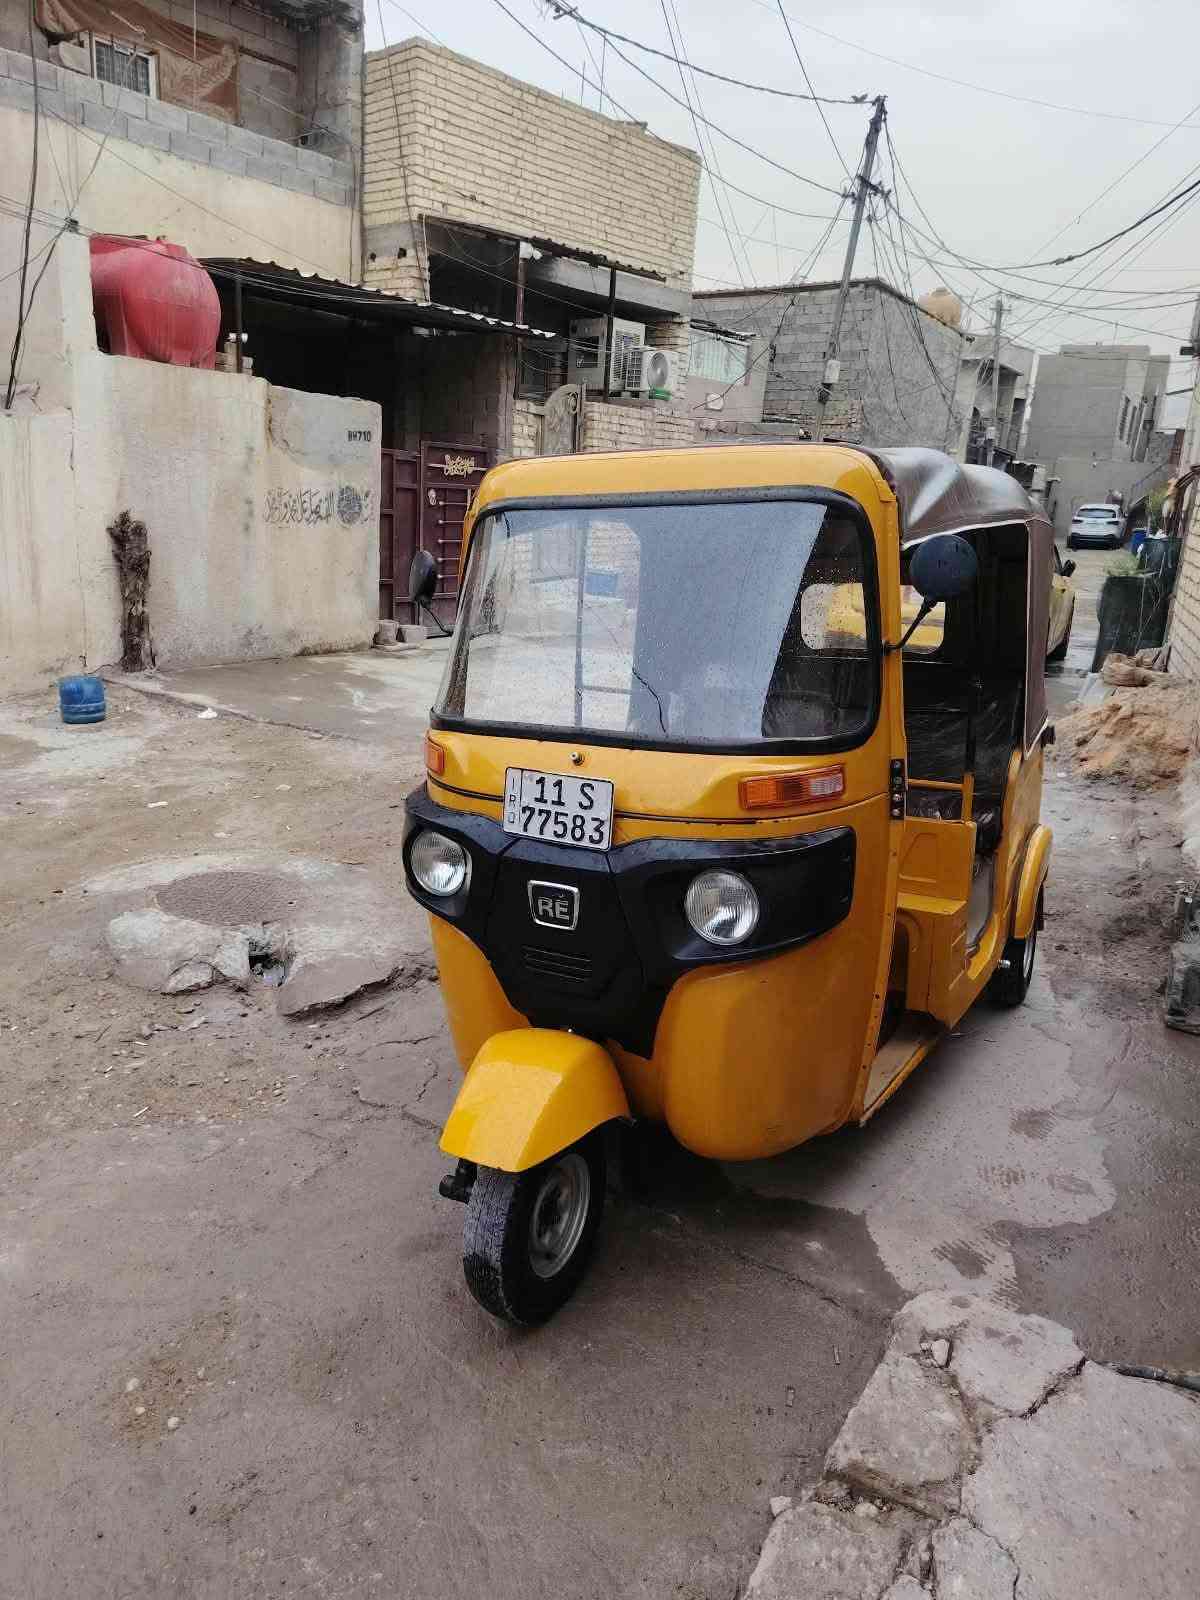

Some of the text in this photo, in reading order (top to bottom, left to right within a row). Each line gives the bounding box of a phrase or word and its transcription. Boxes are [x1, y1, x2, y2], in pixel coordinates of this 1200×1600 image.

[533, 776, 595, 811] 11 S
[521, 805, 605, 845] 77583
